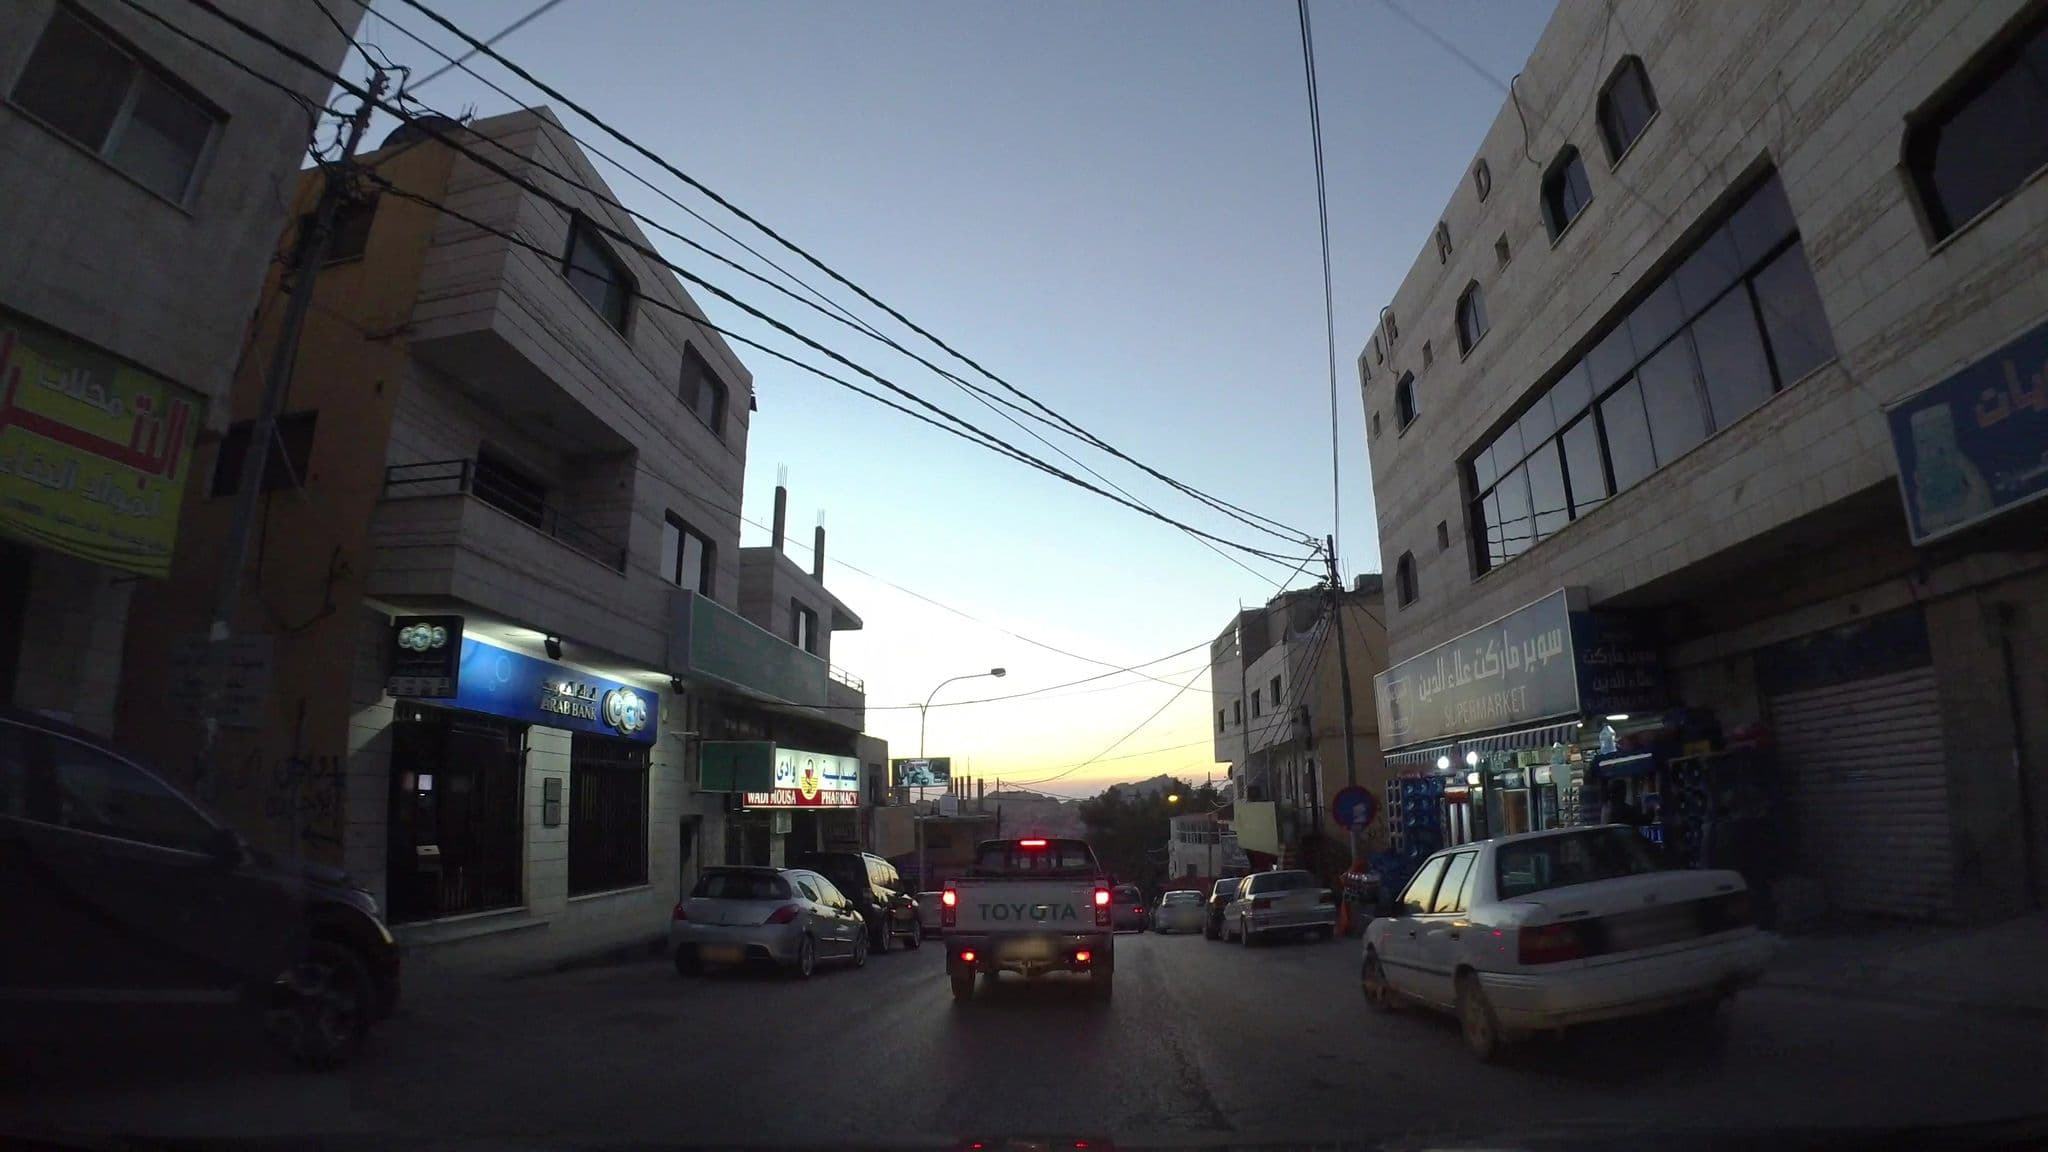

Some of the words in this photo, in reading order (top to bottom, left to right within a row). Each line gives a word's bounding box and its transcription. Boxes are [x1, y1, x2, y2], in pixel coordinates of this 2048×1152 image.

[1447, 649, 1471, 689] علاء
[1474, 629, 1520, 680] ماركت
[1524, 629, 1563, 673] سوبر
[1414, 656, 1446, 702] الدين
[541, 696, 570, 715] ARAB
[572, 703, 597, 721] BANK
[1444, 685, 1527, 729] SUPERMARKET
[747, 792, 769, 805] WADI
[770, 790, 797, 805] MOUSA
[821, 791, 858, 805] PHARMACY
[978, 903, 1077, 921] TOYOTA
